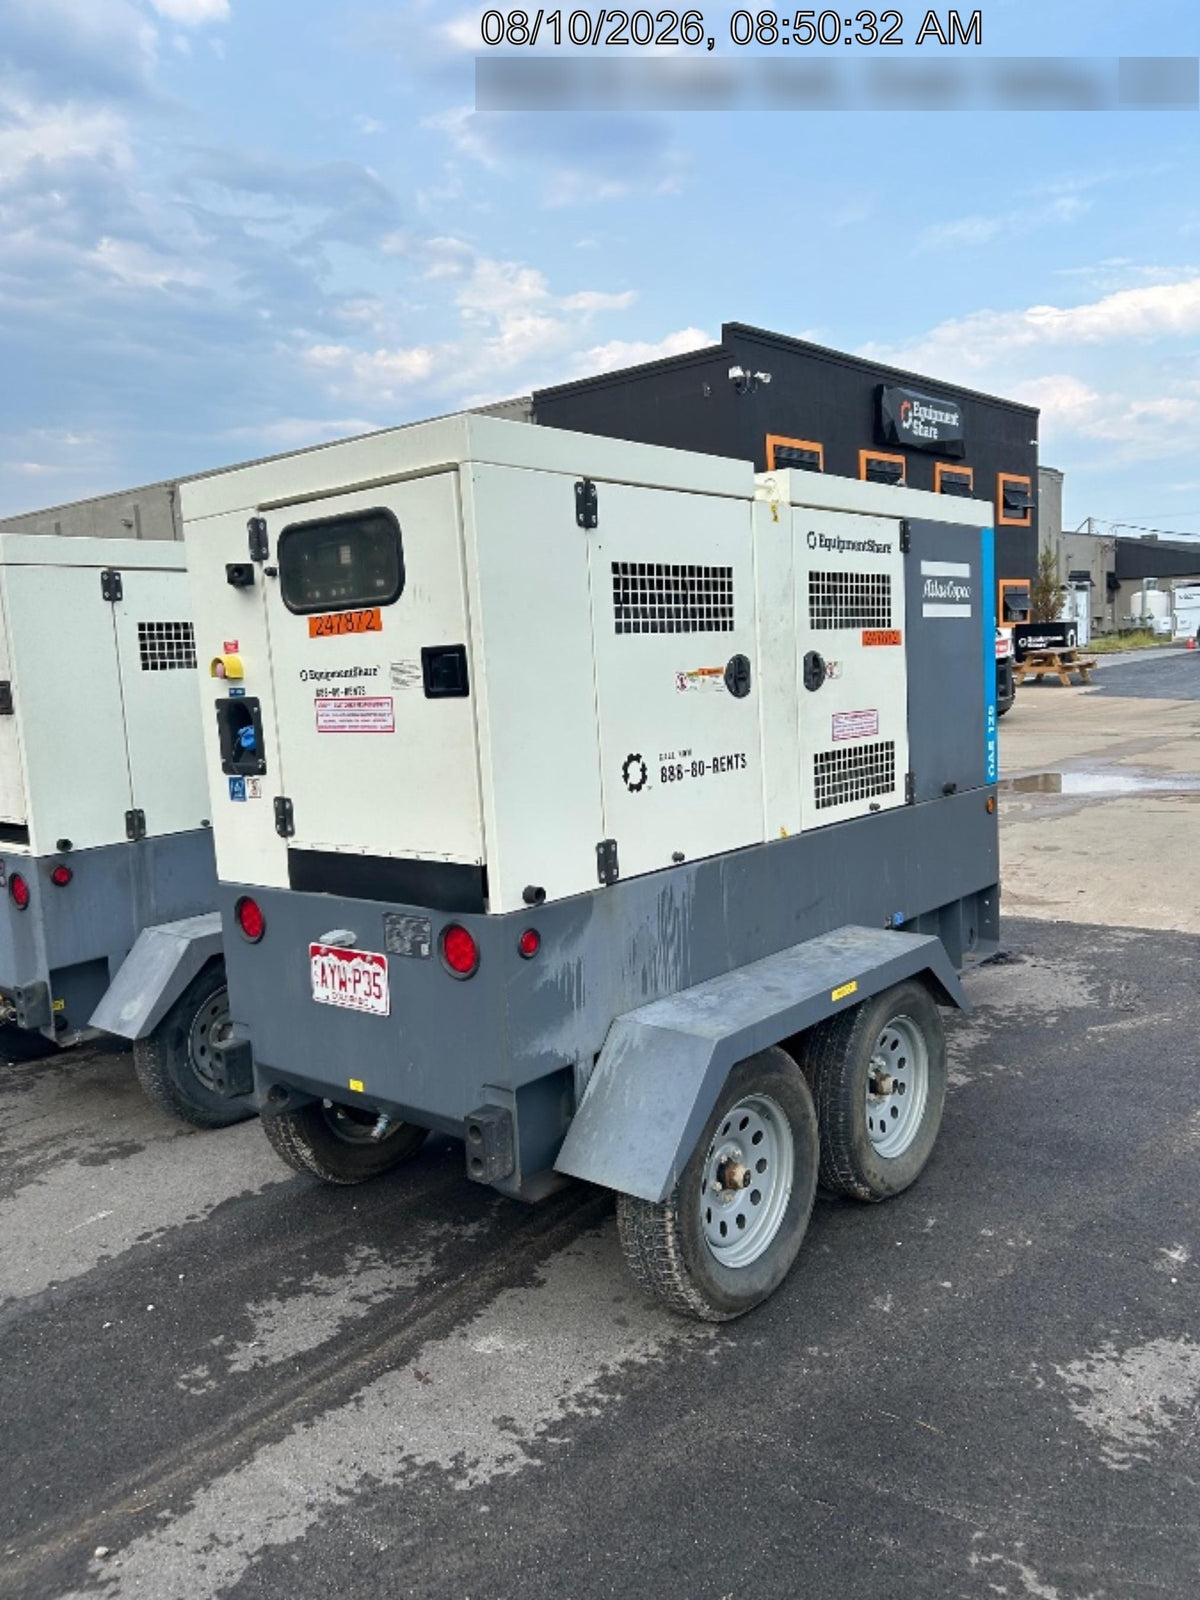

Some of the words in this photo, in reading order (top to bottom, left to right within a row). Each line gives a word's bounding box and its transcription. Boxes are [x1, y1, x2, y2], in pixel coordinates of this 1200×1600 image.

[913, 401, 959, 427] Equipment
[912, 419, 938, 440] Share
[819, 533, 892, 554] EquipmentShare
[315, 610, 376, 635] 247872
[661, 753, 747, 783] 888-80-RENTS
